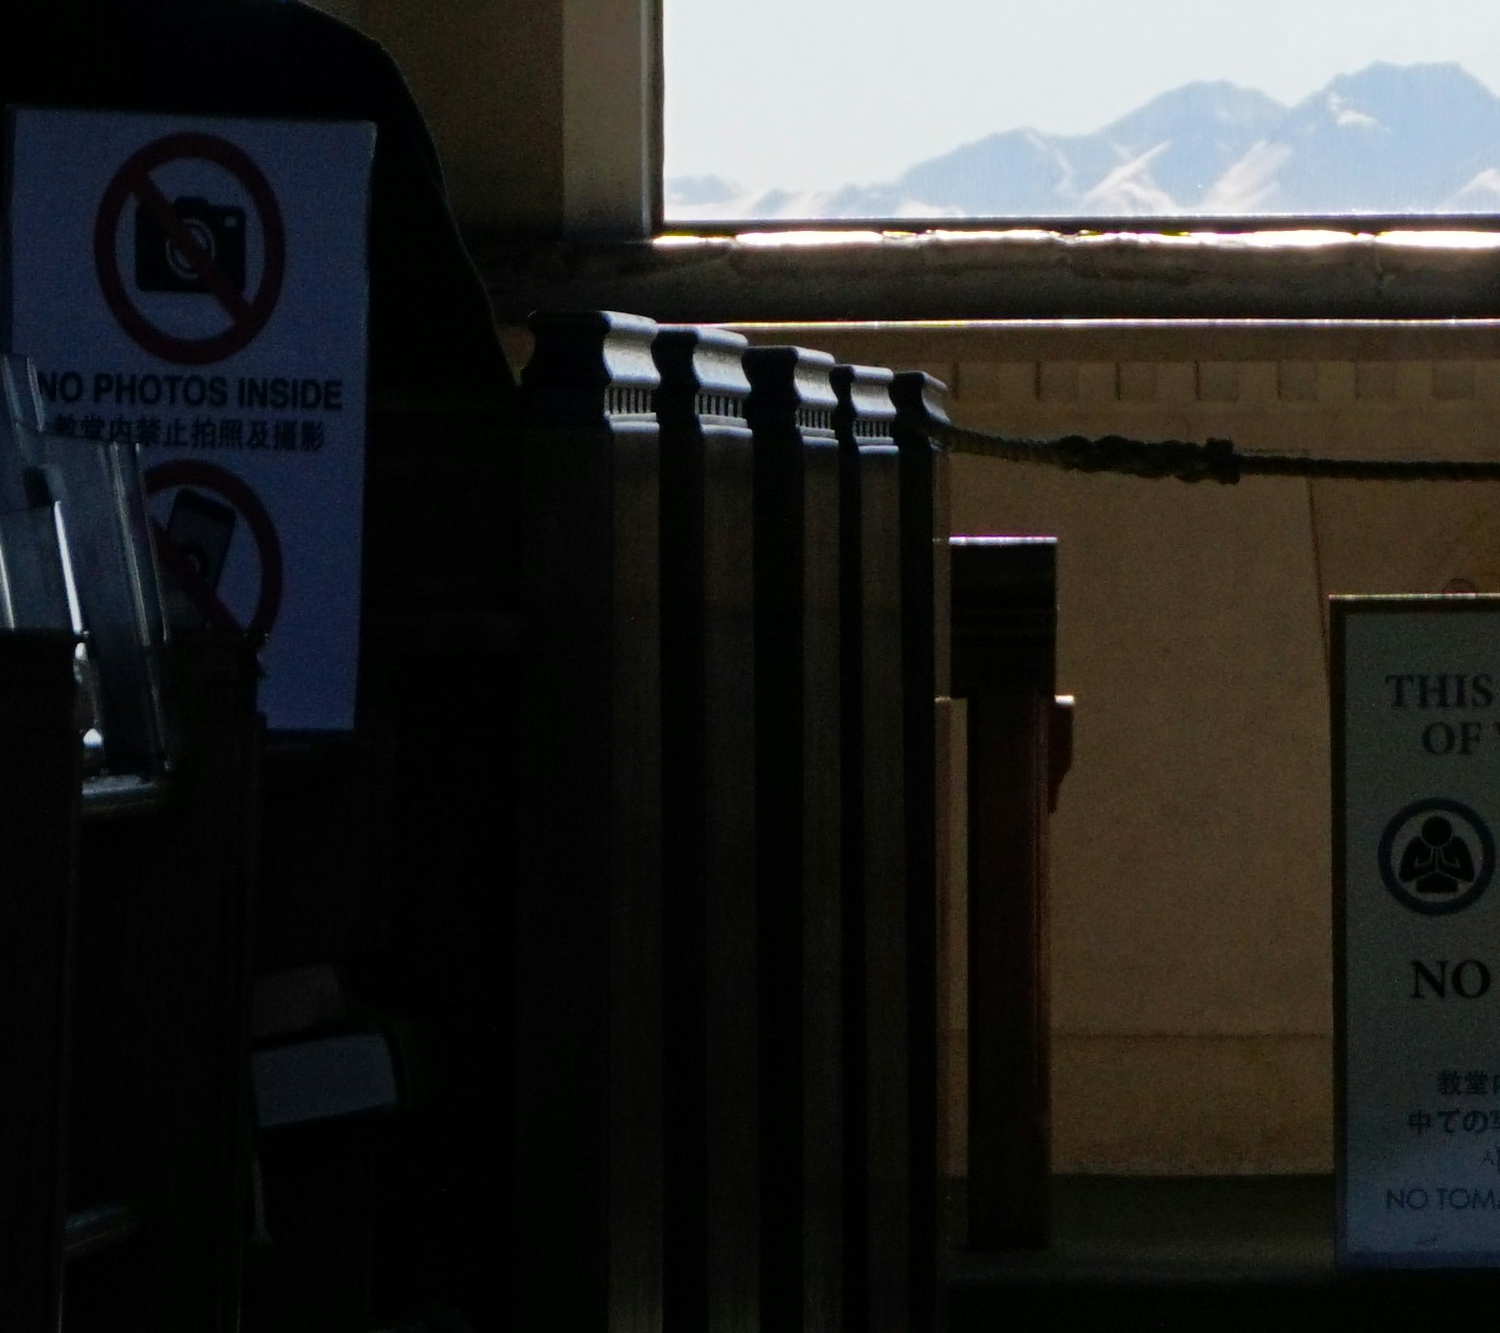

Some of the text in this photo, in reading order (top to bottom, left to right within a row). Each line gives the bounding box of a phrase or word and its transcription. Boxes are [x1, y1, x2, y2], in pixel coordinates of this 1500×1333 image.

[37, 370, 343, 411] NO PHOTOS INSIDE
[1384, 673, 1494, 710] THIS
[1421, 721, 1483, 756] OF
[1409, 959, 1492, 1000] NO
[1385, 1187, 1430, 1211] NO
